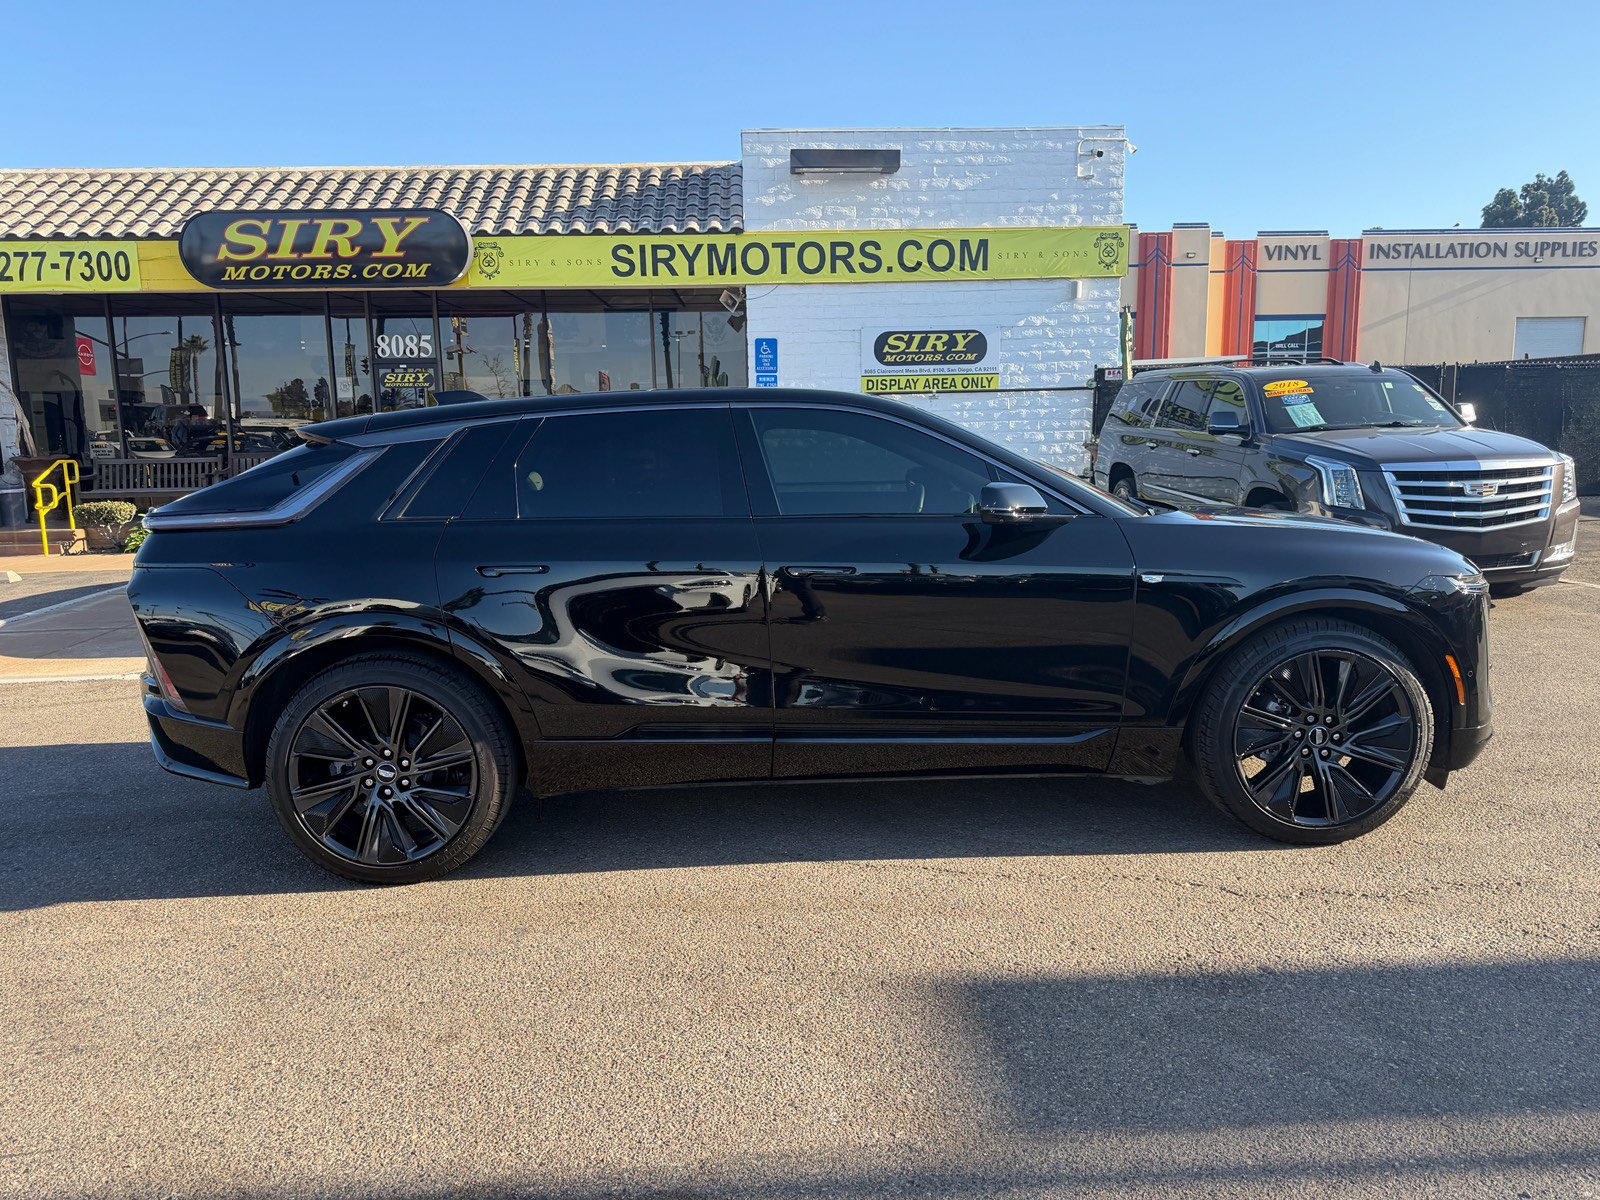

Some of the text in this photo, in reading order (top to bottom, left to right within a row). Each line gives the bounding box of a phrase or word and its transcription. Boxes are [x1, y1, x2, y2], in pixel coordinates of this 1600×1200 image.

[216, 217, 431, 262] SIRY
[611, 238, 989, 278] SIRYMOTORS.COM
[997, 251, 1029, 260] SIRY
[1053, 250, 1089, 258] SONS
[1264, 244, 1322, 261] VINYL
[1369, 239, 1598, 260] INSTALLATION SUPPLIES
[0, 250, 131, 281] 277-7300
[221, 262, 431, 281] MOTORS.COM
[509, 259, 540, 267] SIRY
[566, 258, 602, 266] SONS
[376, 334, 433, 358] 8085
[883, 333, 979, 353] SIRY
[884, 353, 977, 362] MOTORS.COM
[383, 372, 430, 383] SIRY
[866, 376, 994, 391] DISPLAY AREA ONLY
[1272, 381, 1300, 390] 2018
